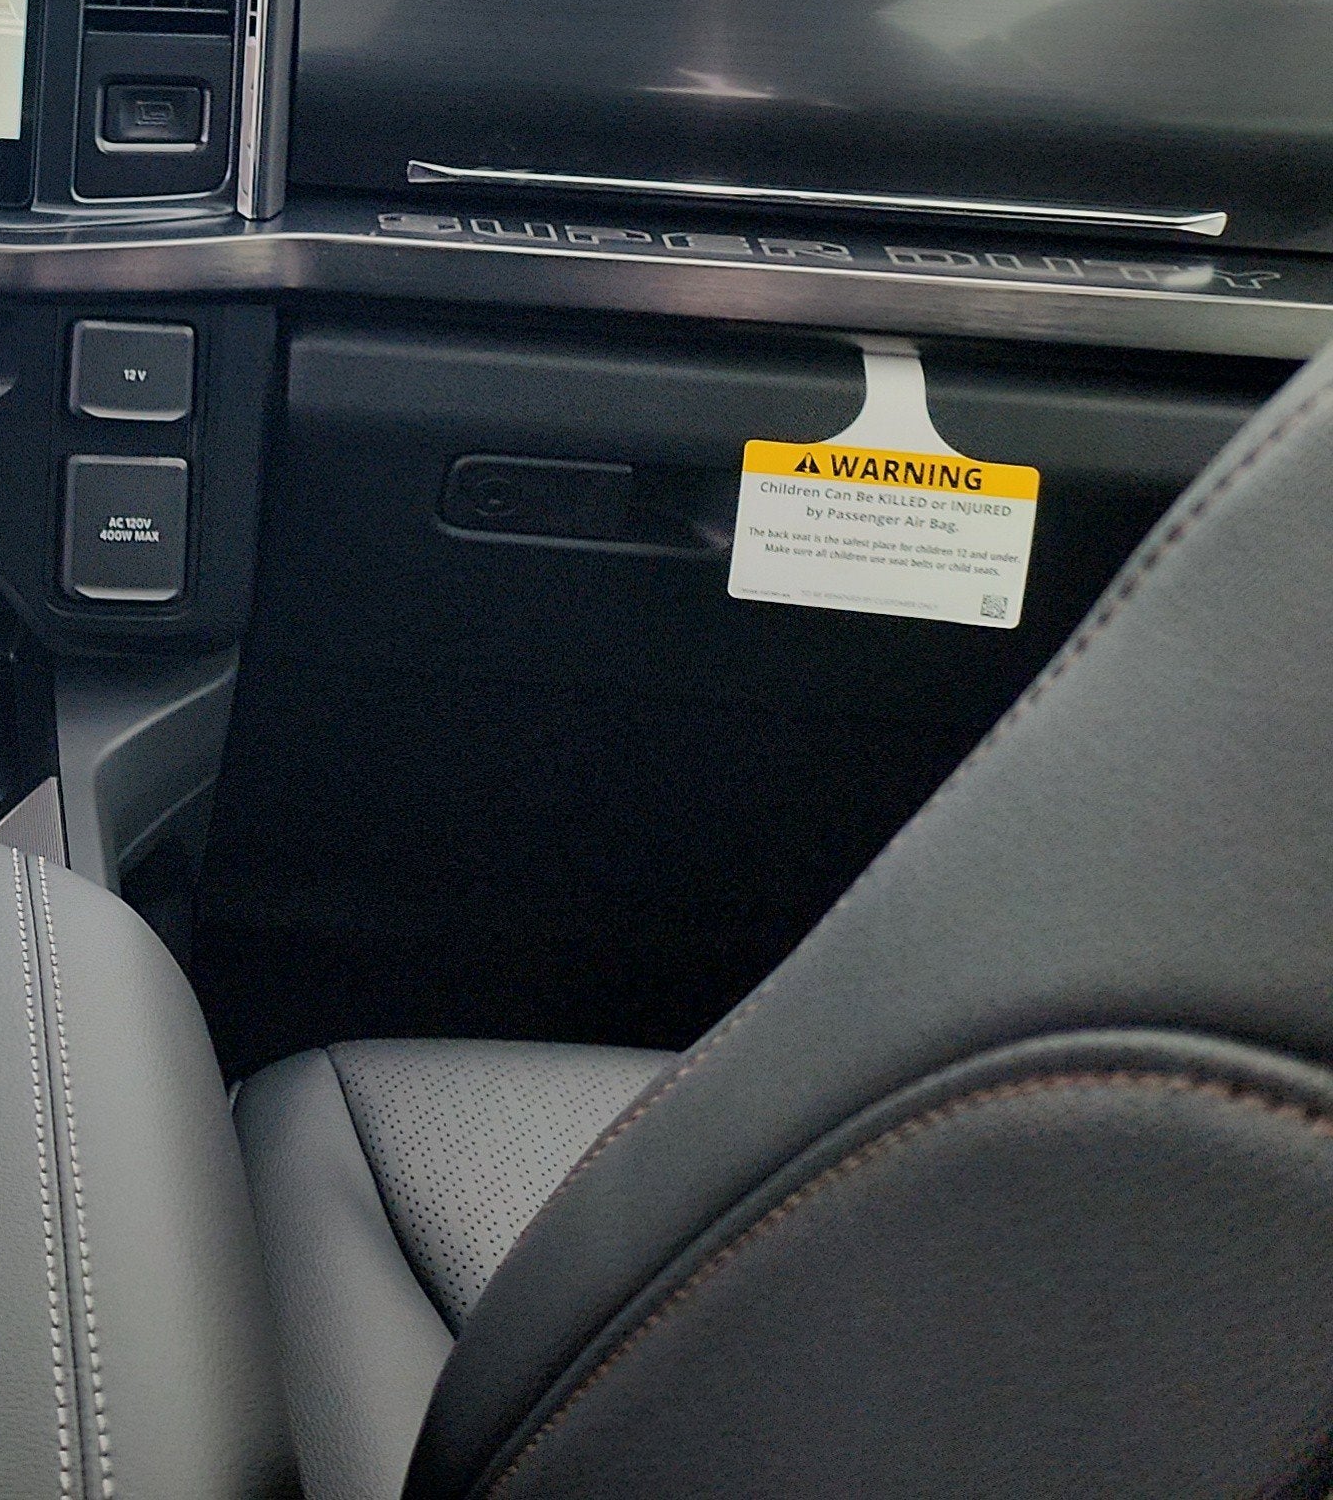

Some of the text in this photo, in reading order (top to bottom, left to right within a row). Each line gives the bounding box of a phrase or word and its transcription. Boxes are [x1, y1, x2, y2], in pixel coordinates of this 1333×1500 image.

[377, 212, 854, 263] SUPER
[884, 244, 1281, 290] DUTY
[831, 453, 983, 491] WARNING
[760, 481, 1013, 518] Children Can Be KILLED or INJURED
[99, 529, 160, 543] 400W MAX
[108, 516, 125, 529] AC
[806, 506, 960, 535] by Passenger Air Bag.
[749, 526, 765, 538] The
[768, 528, 790, 540] back
[793, 532, 811, 542] seat
[814, 533, 821, 543] is
[824, 534, 840, 545] the
[873, 539, 897, 552] place
[900, 541, 913, 552] for
[916, 543, 954, 557] children
[970, 550, 988, 561] and
[765, 543, 790, 556] Make
[816, 549, 827, 559] all
[830, 551, 867, 563] children
[948, 562, 971, 574] child
